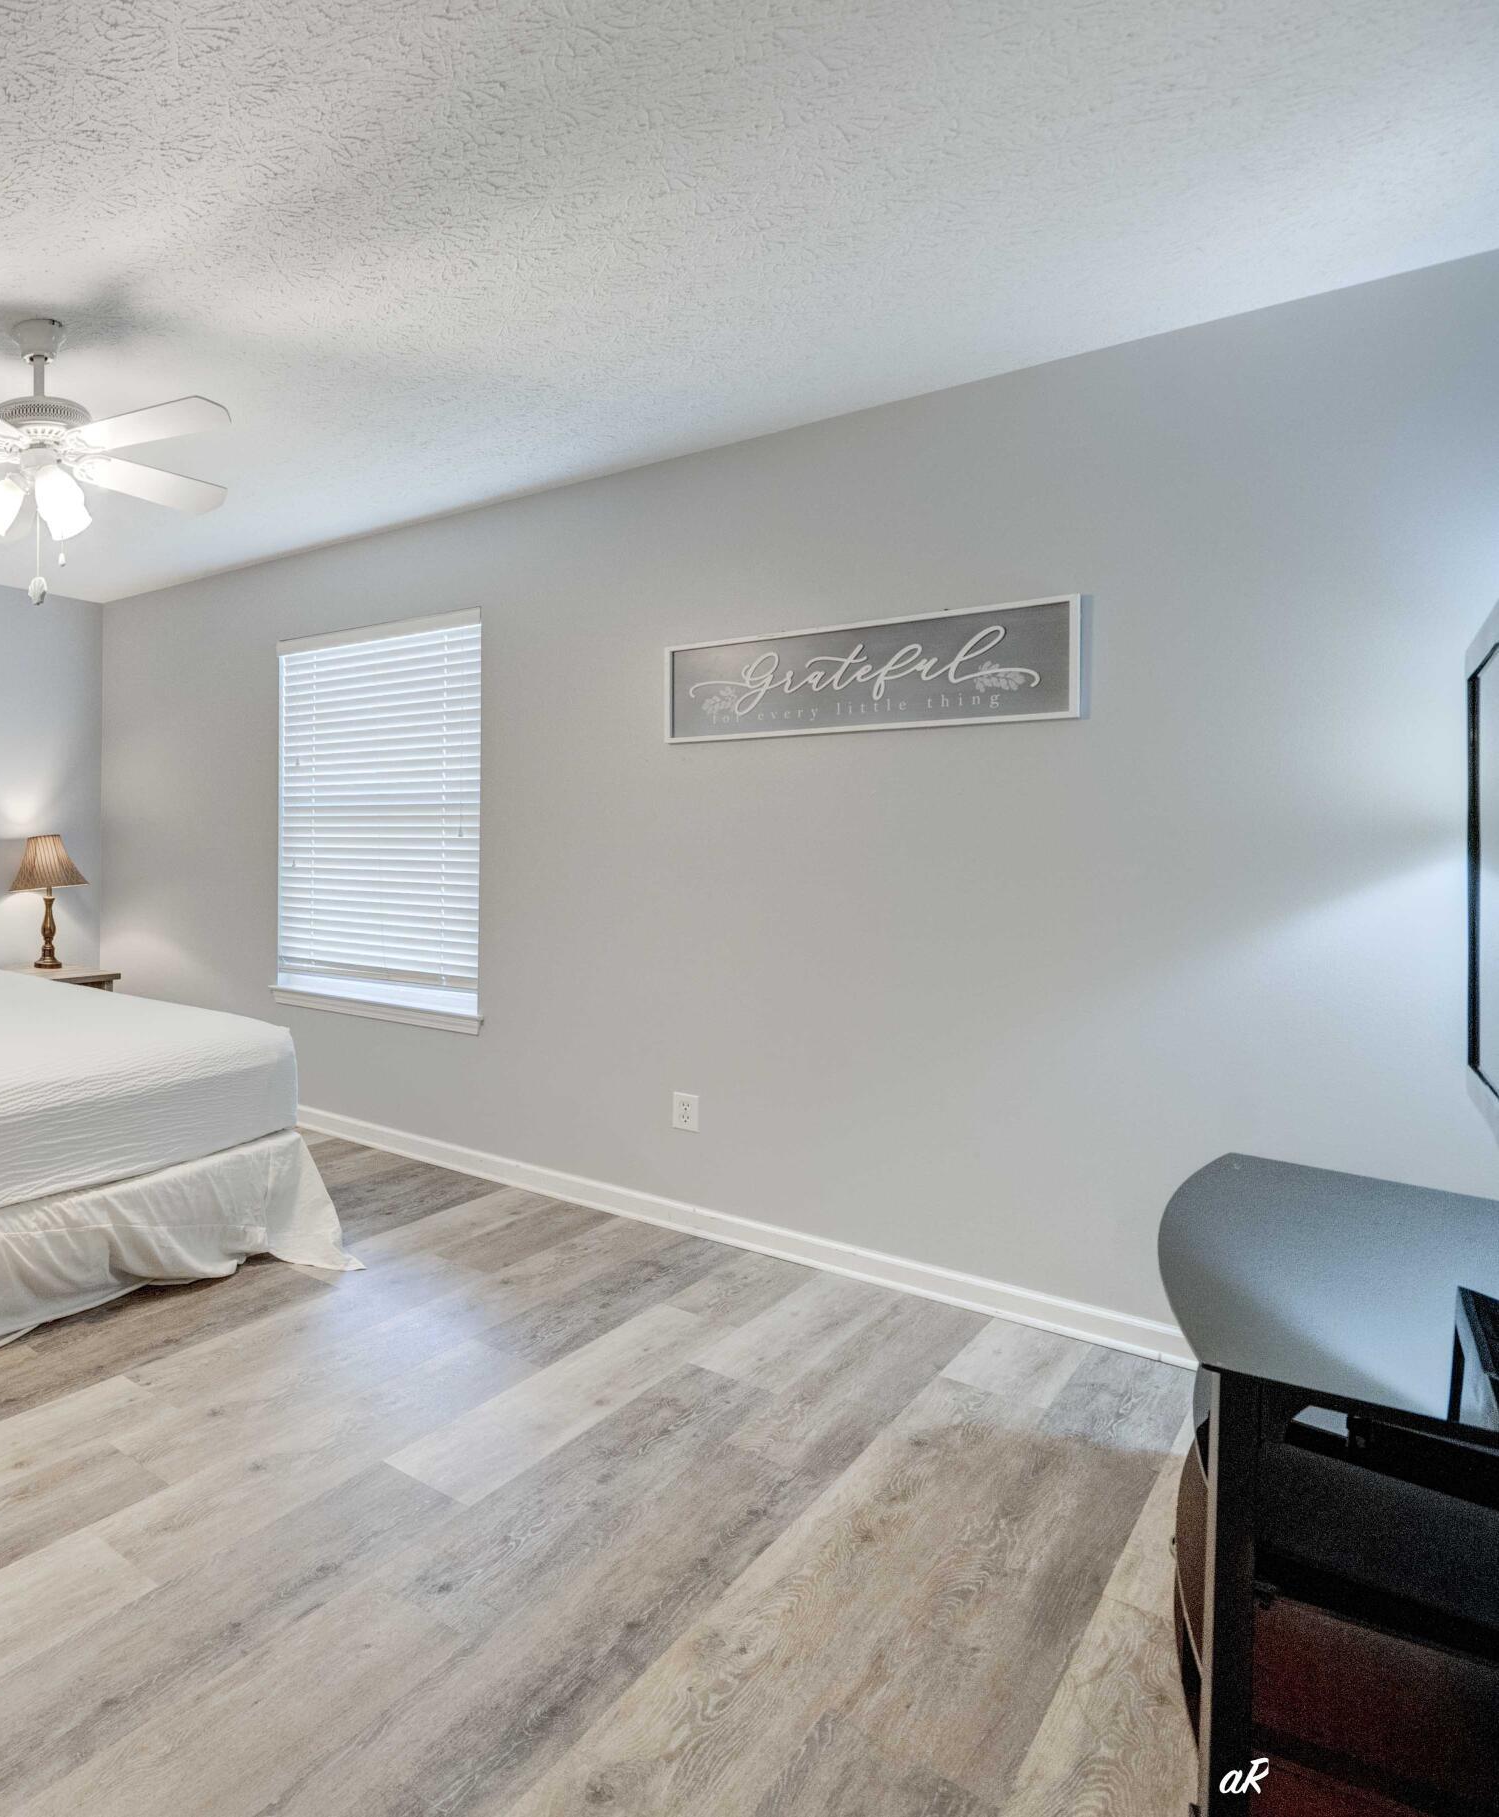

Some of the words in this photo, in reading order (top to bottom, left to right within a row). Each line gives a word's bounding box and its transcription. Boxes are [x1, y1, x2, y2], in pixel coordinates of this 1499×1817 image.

[690, 624, 1041, 716] Grateful
[757, 707, 819, 722] every
[836, 699, 907, 716] little
[927, 692, 1000, 709] thing
